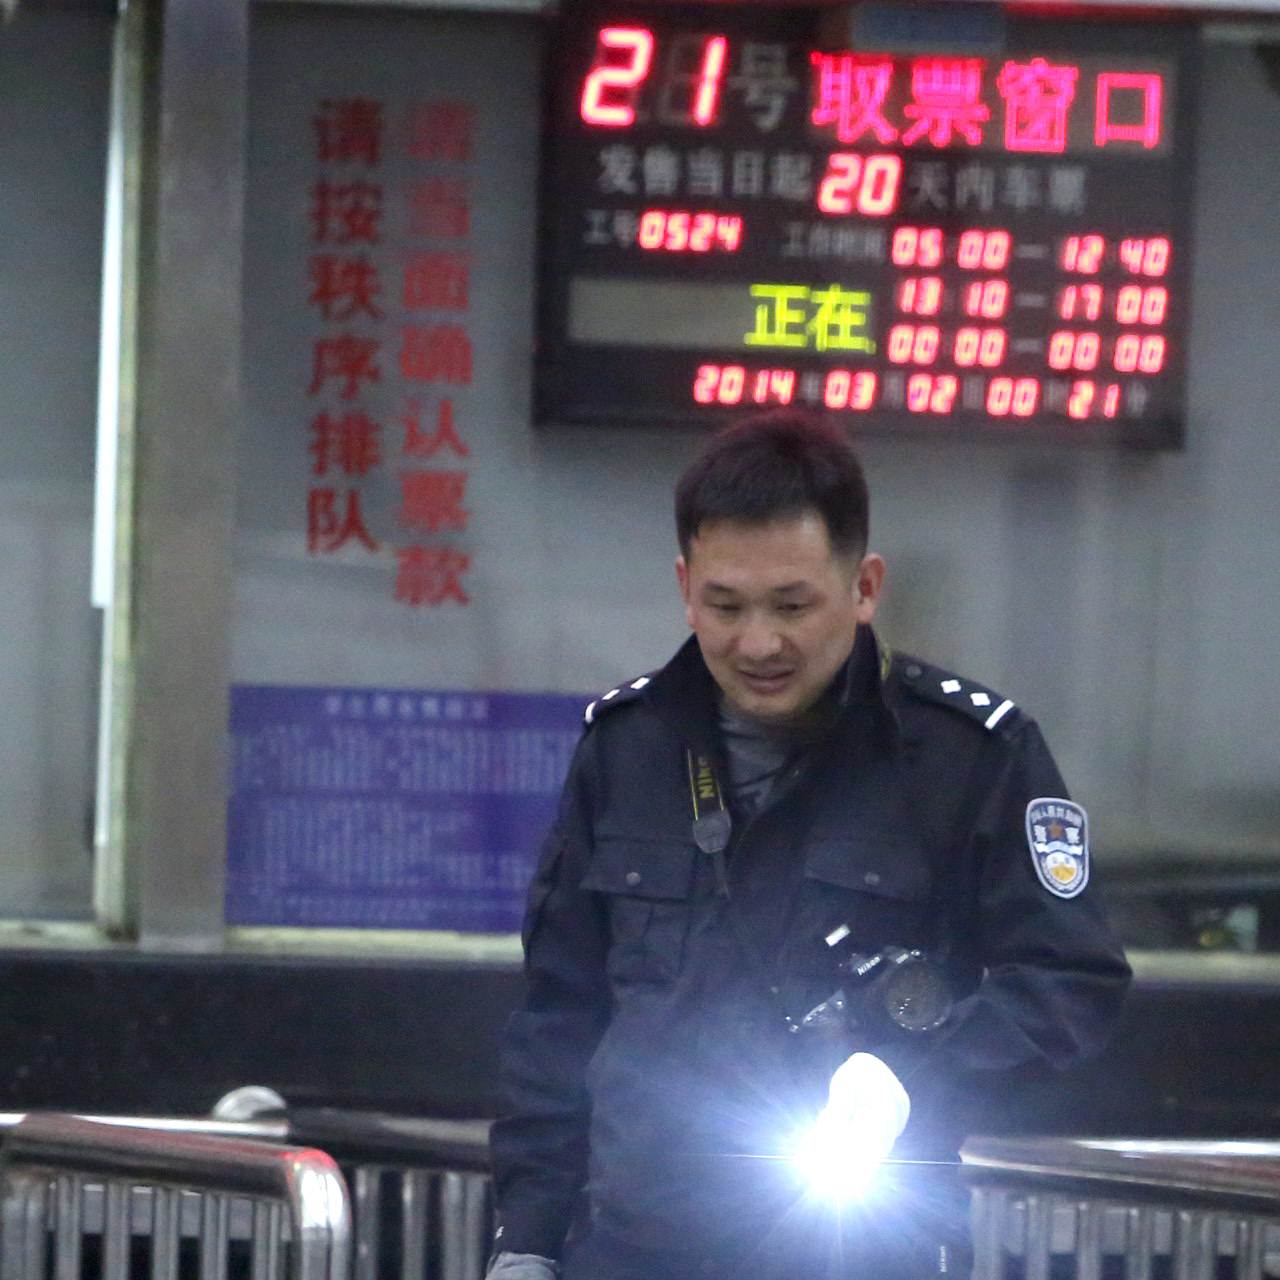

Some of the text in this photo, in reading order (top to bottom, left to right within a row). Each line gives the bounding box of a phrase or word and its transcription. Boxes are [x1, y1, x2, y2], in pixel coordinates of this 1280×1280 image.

[579, 25, 728, 128] 21
[810, 51, 1164, 156] 取票窗口
[817, 150, 904, 217] 20
[637, 209, 743, 252] 0524
[744, 283, 875, 354] 正在
[693, 364, 797, 405] 2014
